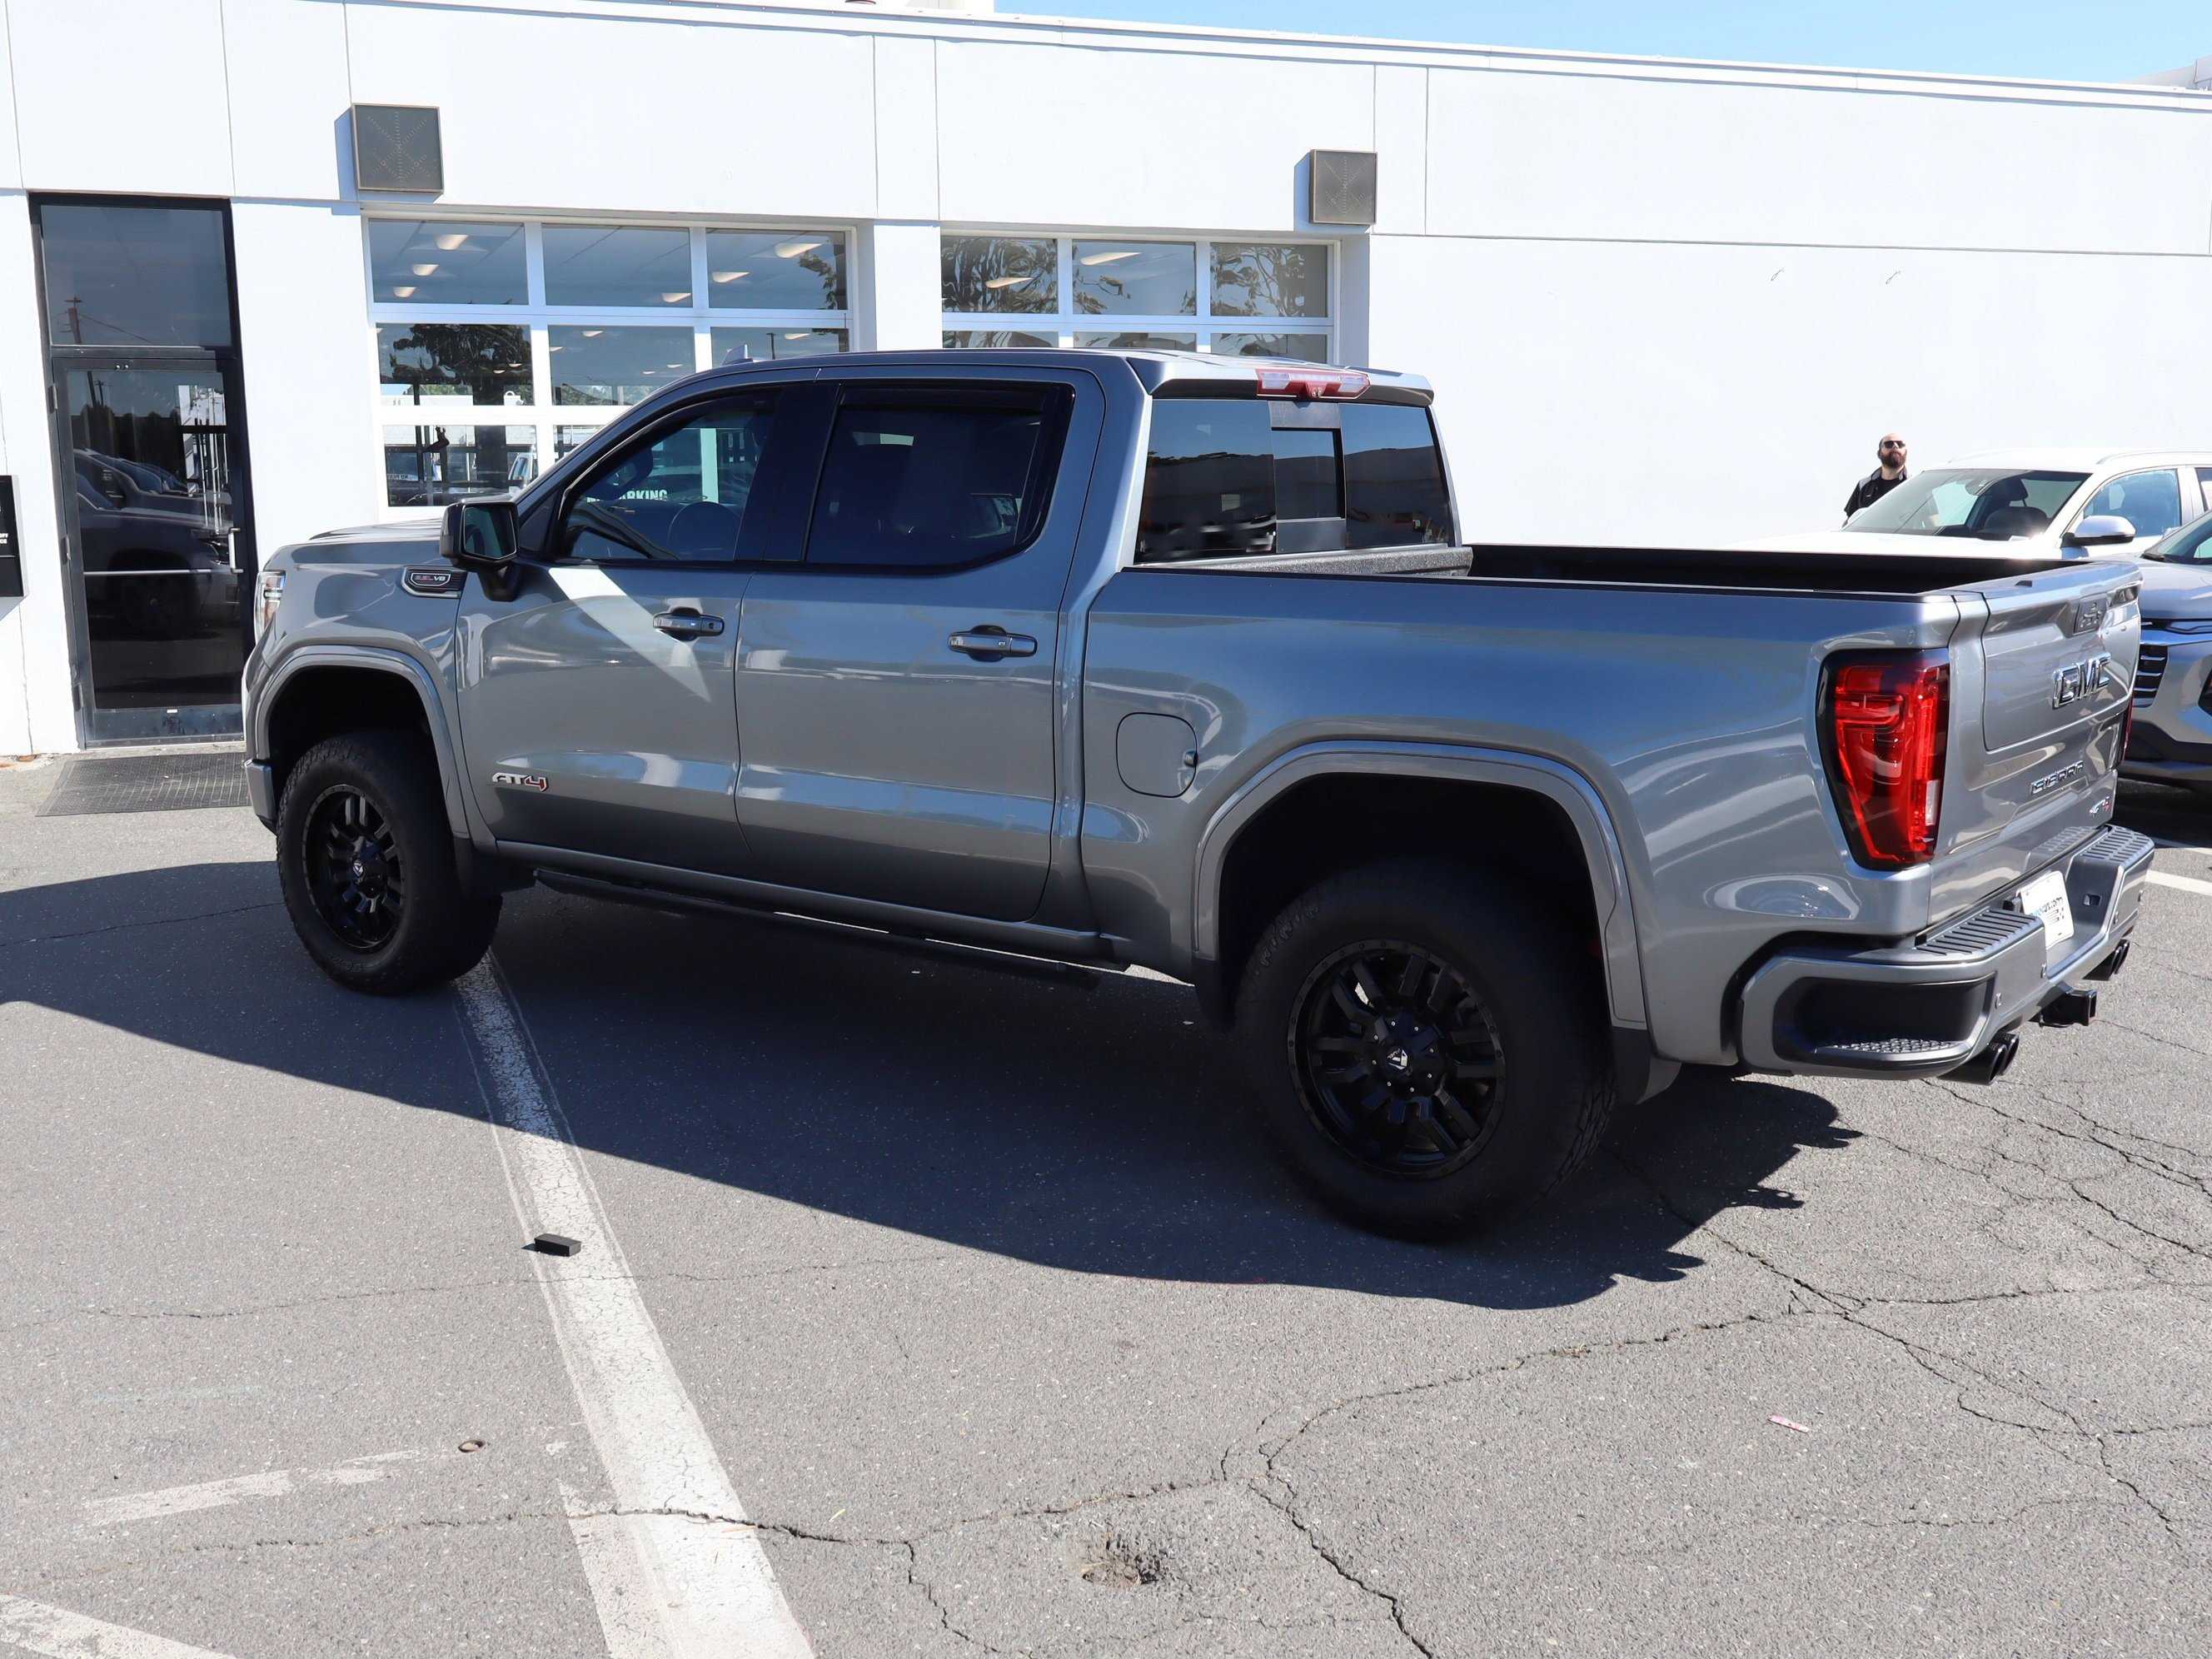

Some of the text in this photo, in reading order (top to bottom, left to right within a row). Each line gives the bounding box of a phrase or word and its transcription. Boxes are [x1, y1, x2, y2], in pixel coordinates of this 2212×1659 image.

[2051, 651, 2111, 710] GMC
[491, 772, 548, 792] AT4
[2030, 760, 2084, 795] SIERRA
